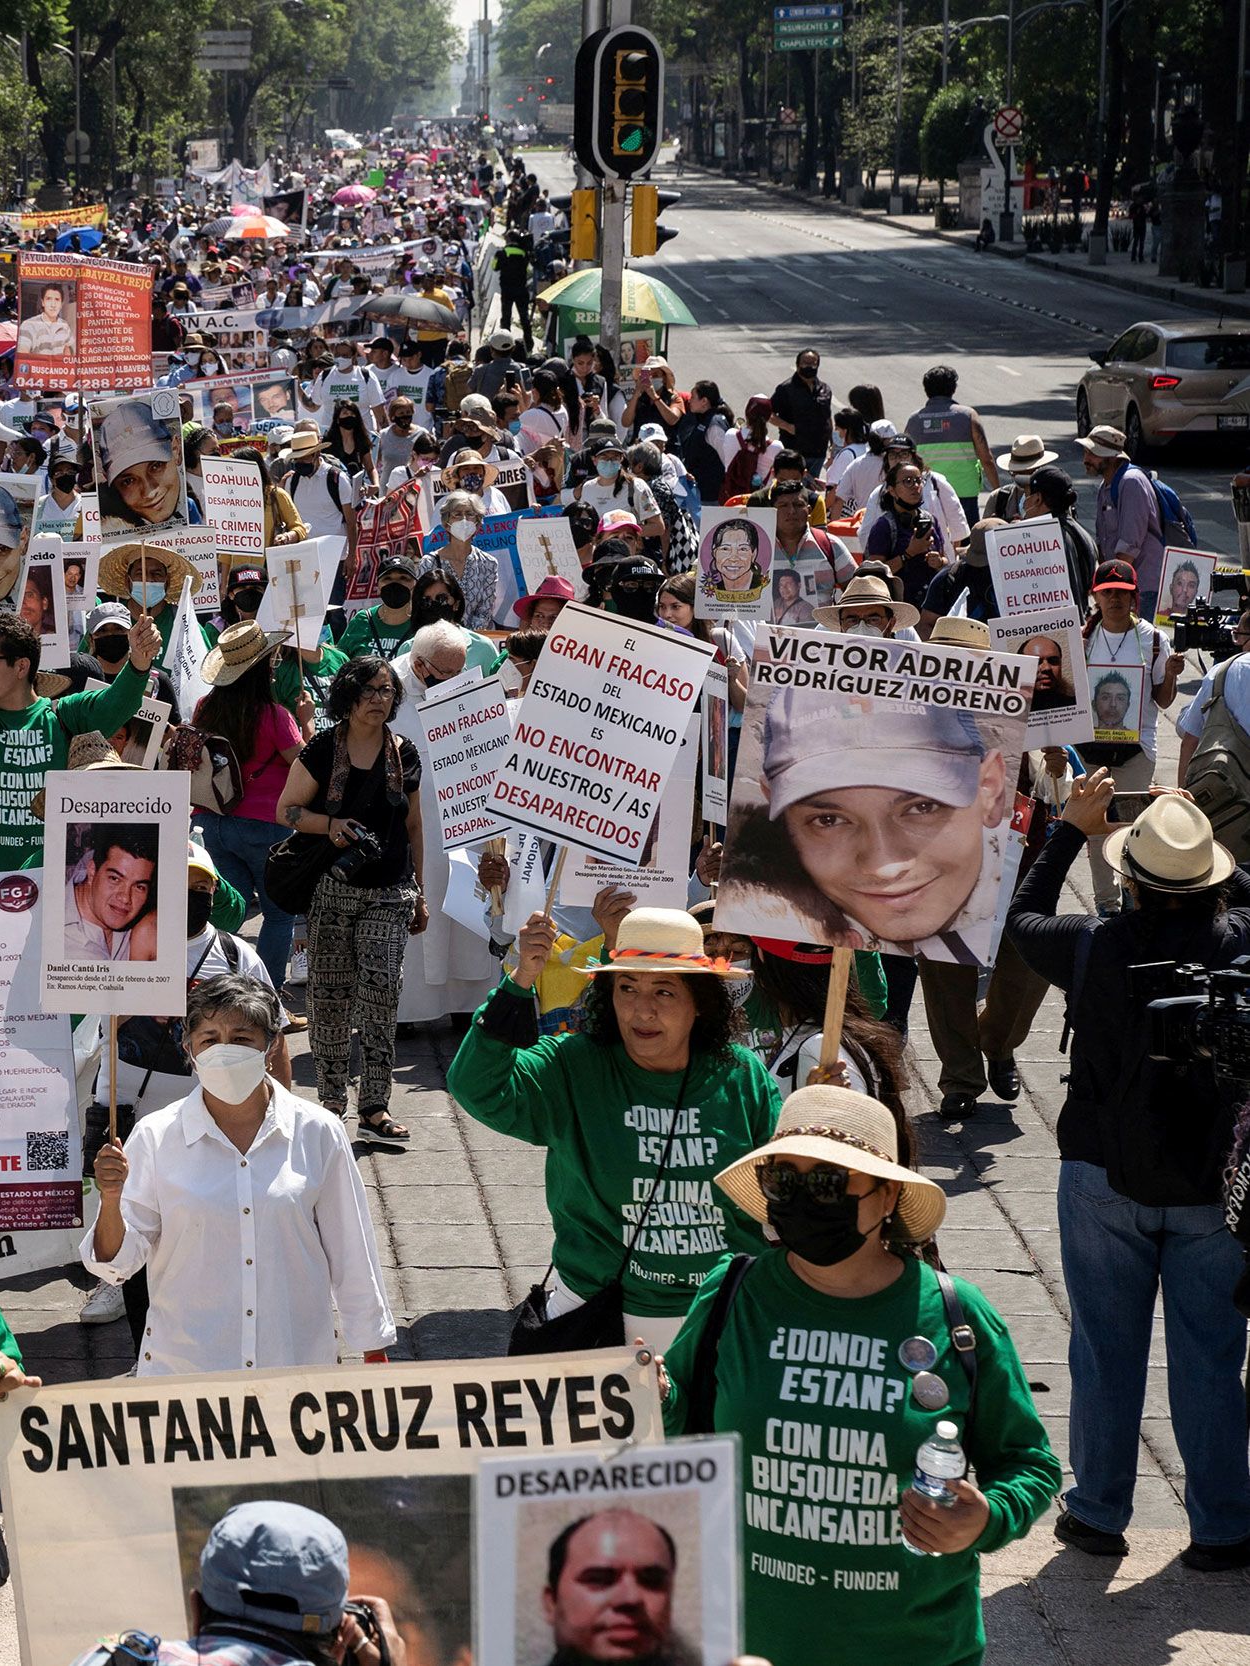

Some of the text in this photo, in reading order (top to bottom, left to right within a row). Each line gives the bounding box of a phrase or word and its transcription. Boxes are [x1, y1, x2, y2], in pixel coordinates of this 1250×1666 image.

[780, 22, 829, 32] INSURGENTES
[780, 39, 828, 47] CHAPULTEPEC
[20, 266, 152, 291] FRANCISCO ALBAVERA TREJO
[16, 377, 150, 389] 044 55 4288 2281
[205, 473, 260, 487] COAHUILA
[208, 497, 262, 508] DESAPARICIÓN
[221, 520, 262, 533] CRIMEN
[1000, 539, 1061, 557] COAHUILA
[237, 570, 260, 581] MARVEL
[1004, 564, 1065, 580] DESAPARICIÓN
[1023, 589, 1069, 606] CRIMEN
[997, 619, 1074, 638] Desaparecido
[624, 638, 636, 651] EL
[550, 634, 694, 702] GRAN FRACASO
[768, 636, 1021, 689] VICTOR ADRIÁN
[602, 683, 622, 699] DEL
[756, 664, 1024, 714] RODRÍGUEZ MORENO
[532, 680, 677, 746] ESTADO MEXICANO
[428, 704, 505, 743] GRAN FRACASO
[590, 727, 605, 740] ES
[4, 744, 53, 766] ESTAN?
[432, 734, 510, 772] ESTADO MEXICANO
[515, 723, 662, 792] NO ENCONTRAR
[505, 753, 651, 819] A NUESTROS AS
[61, 797, 172, 817] Desaparecido
[494, 781, 642, 849] DESAPARECIDOS
[0, 886, 33, 900] FGJ
[47, 964, 109, 973] Daniel Cantú Iris
[47, 974, 83, 983] Desaparecido
[98, 983, 124, 991] Coahuila
[44, 1189, 75, 1197] MÉXICO
[768, 1326, 889, 1371] ¿DONDE
[779, 1366, 905, 1414] ESTAN?
[20, 1372, 636, 1474] SANTANA CRUZ REYES
[766, 1417, 888, 1467] CON UNA
[494, 1456, 719, 1500] DESAPARECIDO
[751, 1454, 899, 1505] BUSQUEDA
[745, 1492, 903, 1546] INCANSABLE
[751, 1552, 899, 1591] FUUNDEC FUNDEM
